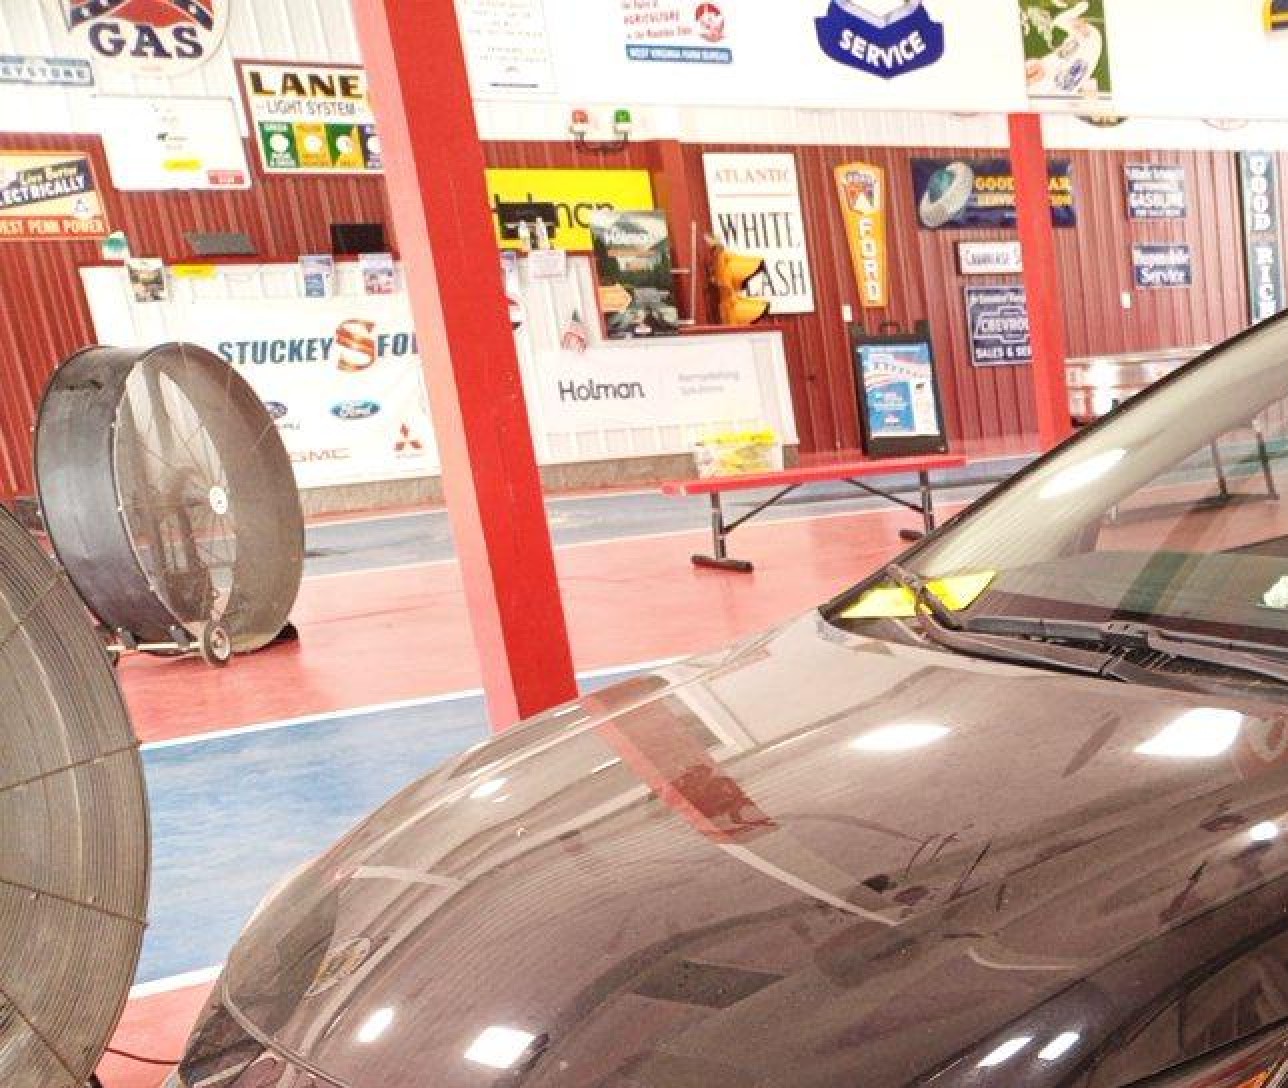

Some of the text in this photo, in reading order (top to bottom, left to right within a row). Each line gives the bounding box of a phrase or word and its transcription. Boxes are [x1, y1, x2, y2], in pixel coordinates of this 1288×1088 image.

[88, 21, 205, 60] GAS
[838, 28, 928, 69] SERVICE
[0, 65, 91, 82] EYSTONE
[248, 70, 364, 99] LANE
[267, 99, 356, 117] LIGHT SYSTEM
[0, 175, 86, 205] ECTRICALLY
[217, 337, 335, 365] STUCKEY
[376, 332, 417, 358] FO
[557, 378, 646, 402] Holman
